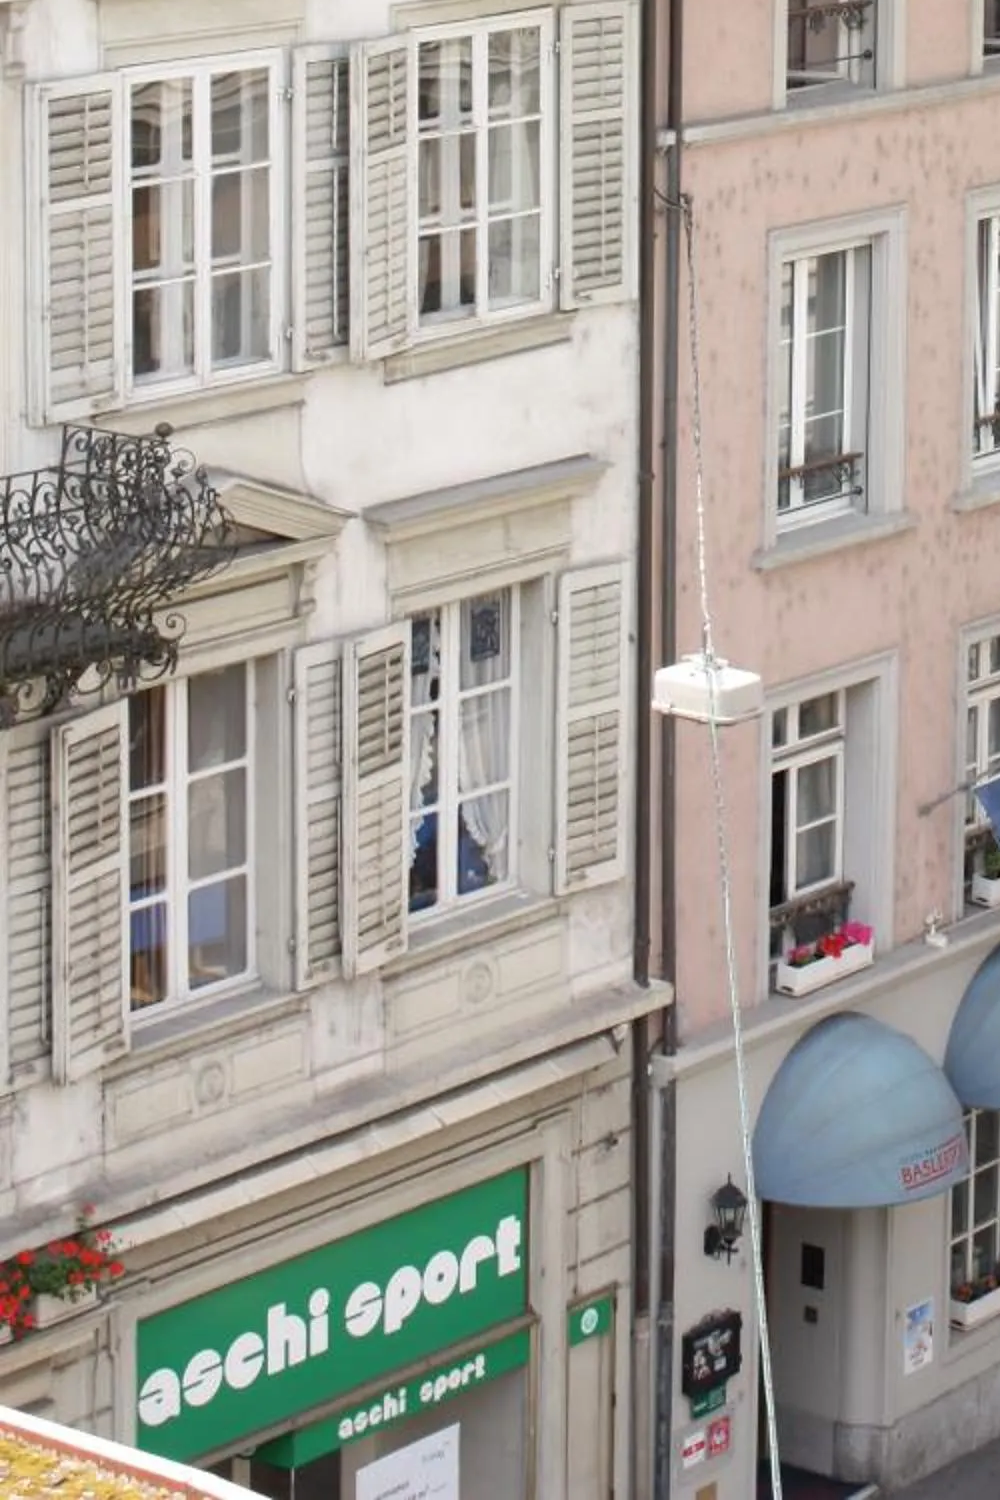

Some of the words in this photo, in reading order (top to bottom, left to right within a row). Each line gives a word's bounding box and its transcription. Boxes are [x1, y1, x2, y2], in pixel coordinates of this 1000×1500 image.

[138, 1286, 329, 1428] aschi
[344, 1213, 522, 1338] sport
[337, 1386, 407, 1440] aschi
[418, 1352, 487, 1403] sport
